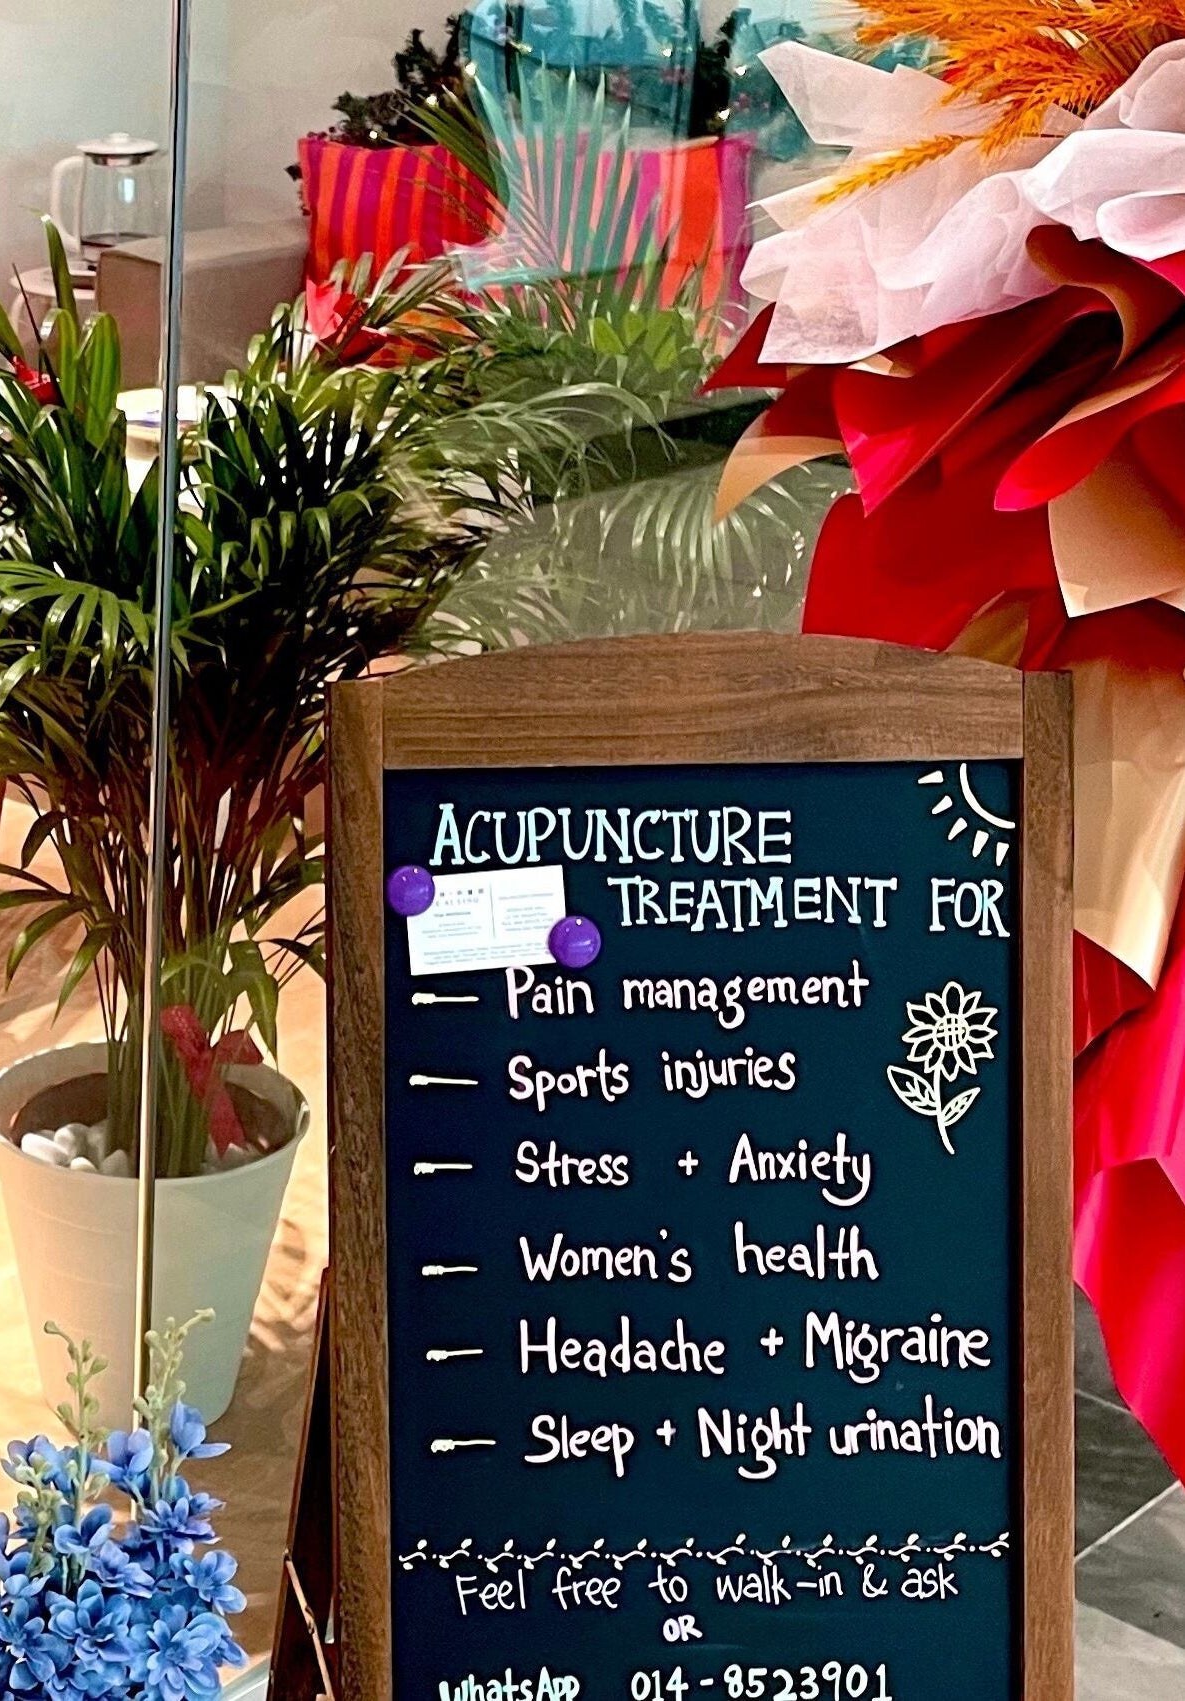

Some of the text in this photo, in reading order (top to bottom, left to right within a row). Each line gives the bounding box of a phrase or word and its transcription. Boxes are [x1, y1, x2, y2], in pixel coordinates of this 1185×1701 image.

[428, 803, 792, 867] ACUPUNCTURE
[607, 876, 898, 932] TREATMENT
[929, 878, 1011, 938] FOR
[505, 959, 870, 1030] Pain management
[508, 1046, 796, 1112] Sports injuries
[515, 1140, 629, 1188] Stress
[728, 1132, 871, 1207] Anxiety
[519, 1221, 880, 1283] Women's health
[519, 1315, 725, 1378] Headache
[805, 1311, 991, 1384] Migraine
[524, 1414, 635, 1478] Sleep
[697, 1402, 812, 1480] Night
[829, 1394, 1002, 1459] urination
[455, 1565, 526, 1616] Feel
[551, 1567, 623, 1610] free
[647, 1559, 688, 1604] to
[862, 1565, 890, 1598] &
[900, 1562, 959, 1600] ask
[662, 1614, 703, 1642] OR
